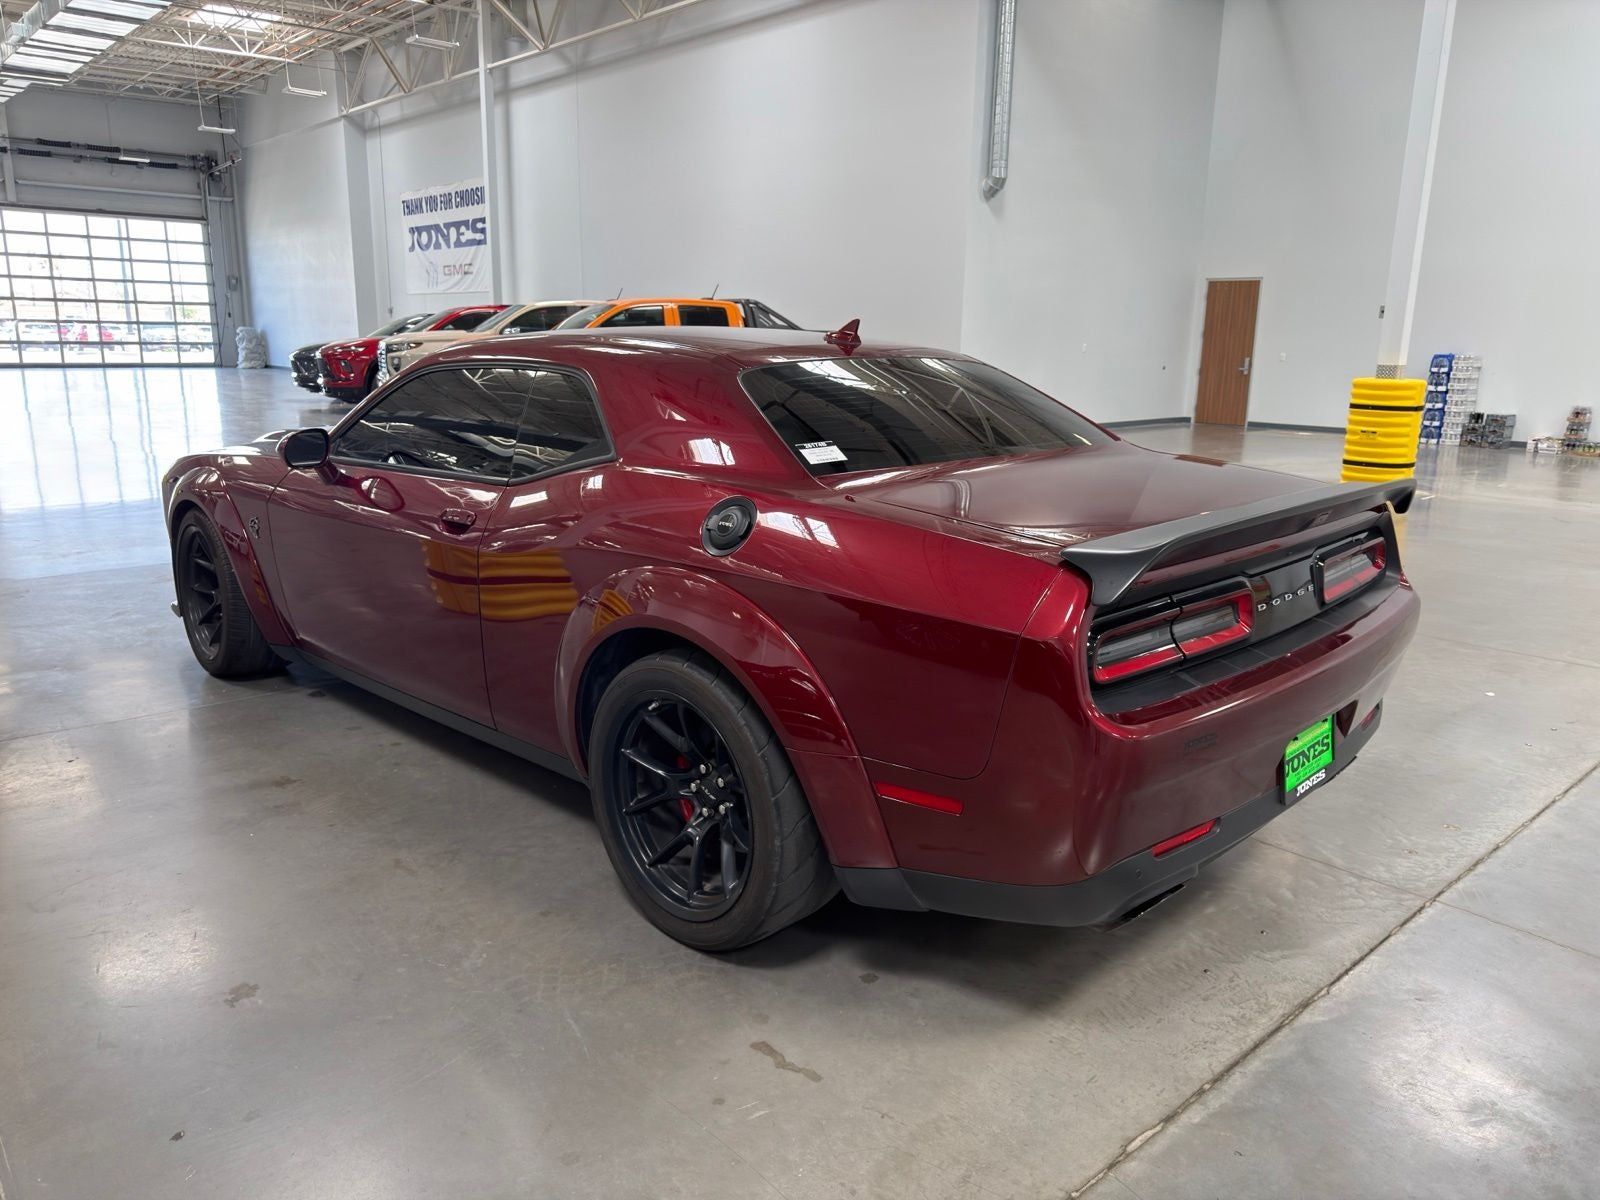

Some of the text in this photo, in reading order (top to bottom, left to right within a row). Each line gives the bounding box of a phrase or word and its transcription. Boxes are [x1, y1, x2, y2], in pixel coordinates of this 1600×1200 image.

[402, 197, 424, 216] THANK
[424, 195, 439, 213] YOU
[439, 192, 454, 211] FOR
[408, 216, 487, 252] JONES
[443, 263, 474, 277] GMC
[1257, 583, 1314, 612] DODGE
[1285, 733, 1330, 778] JONES
[1296, 768, 1326, 797] JONES
